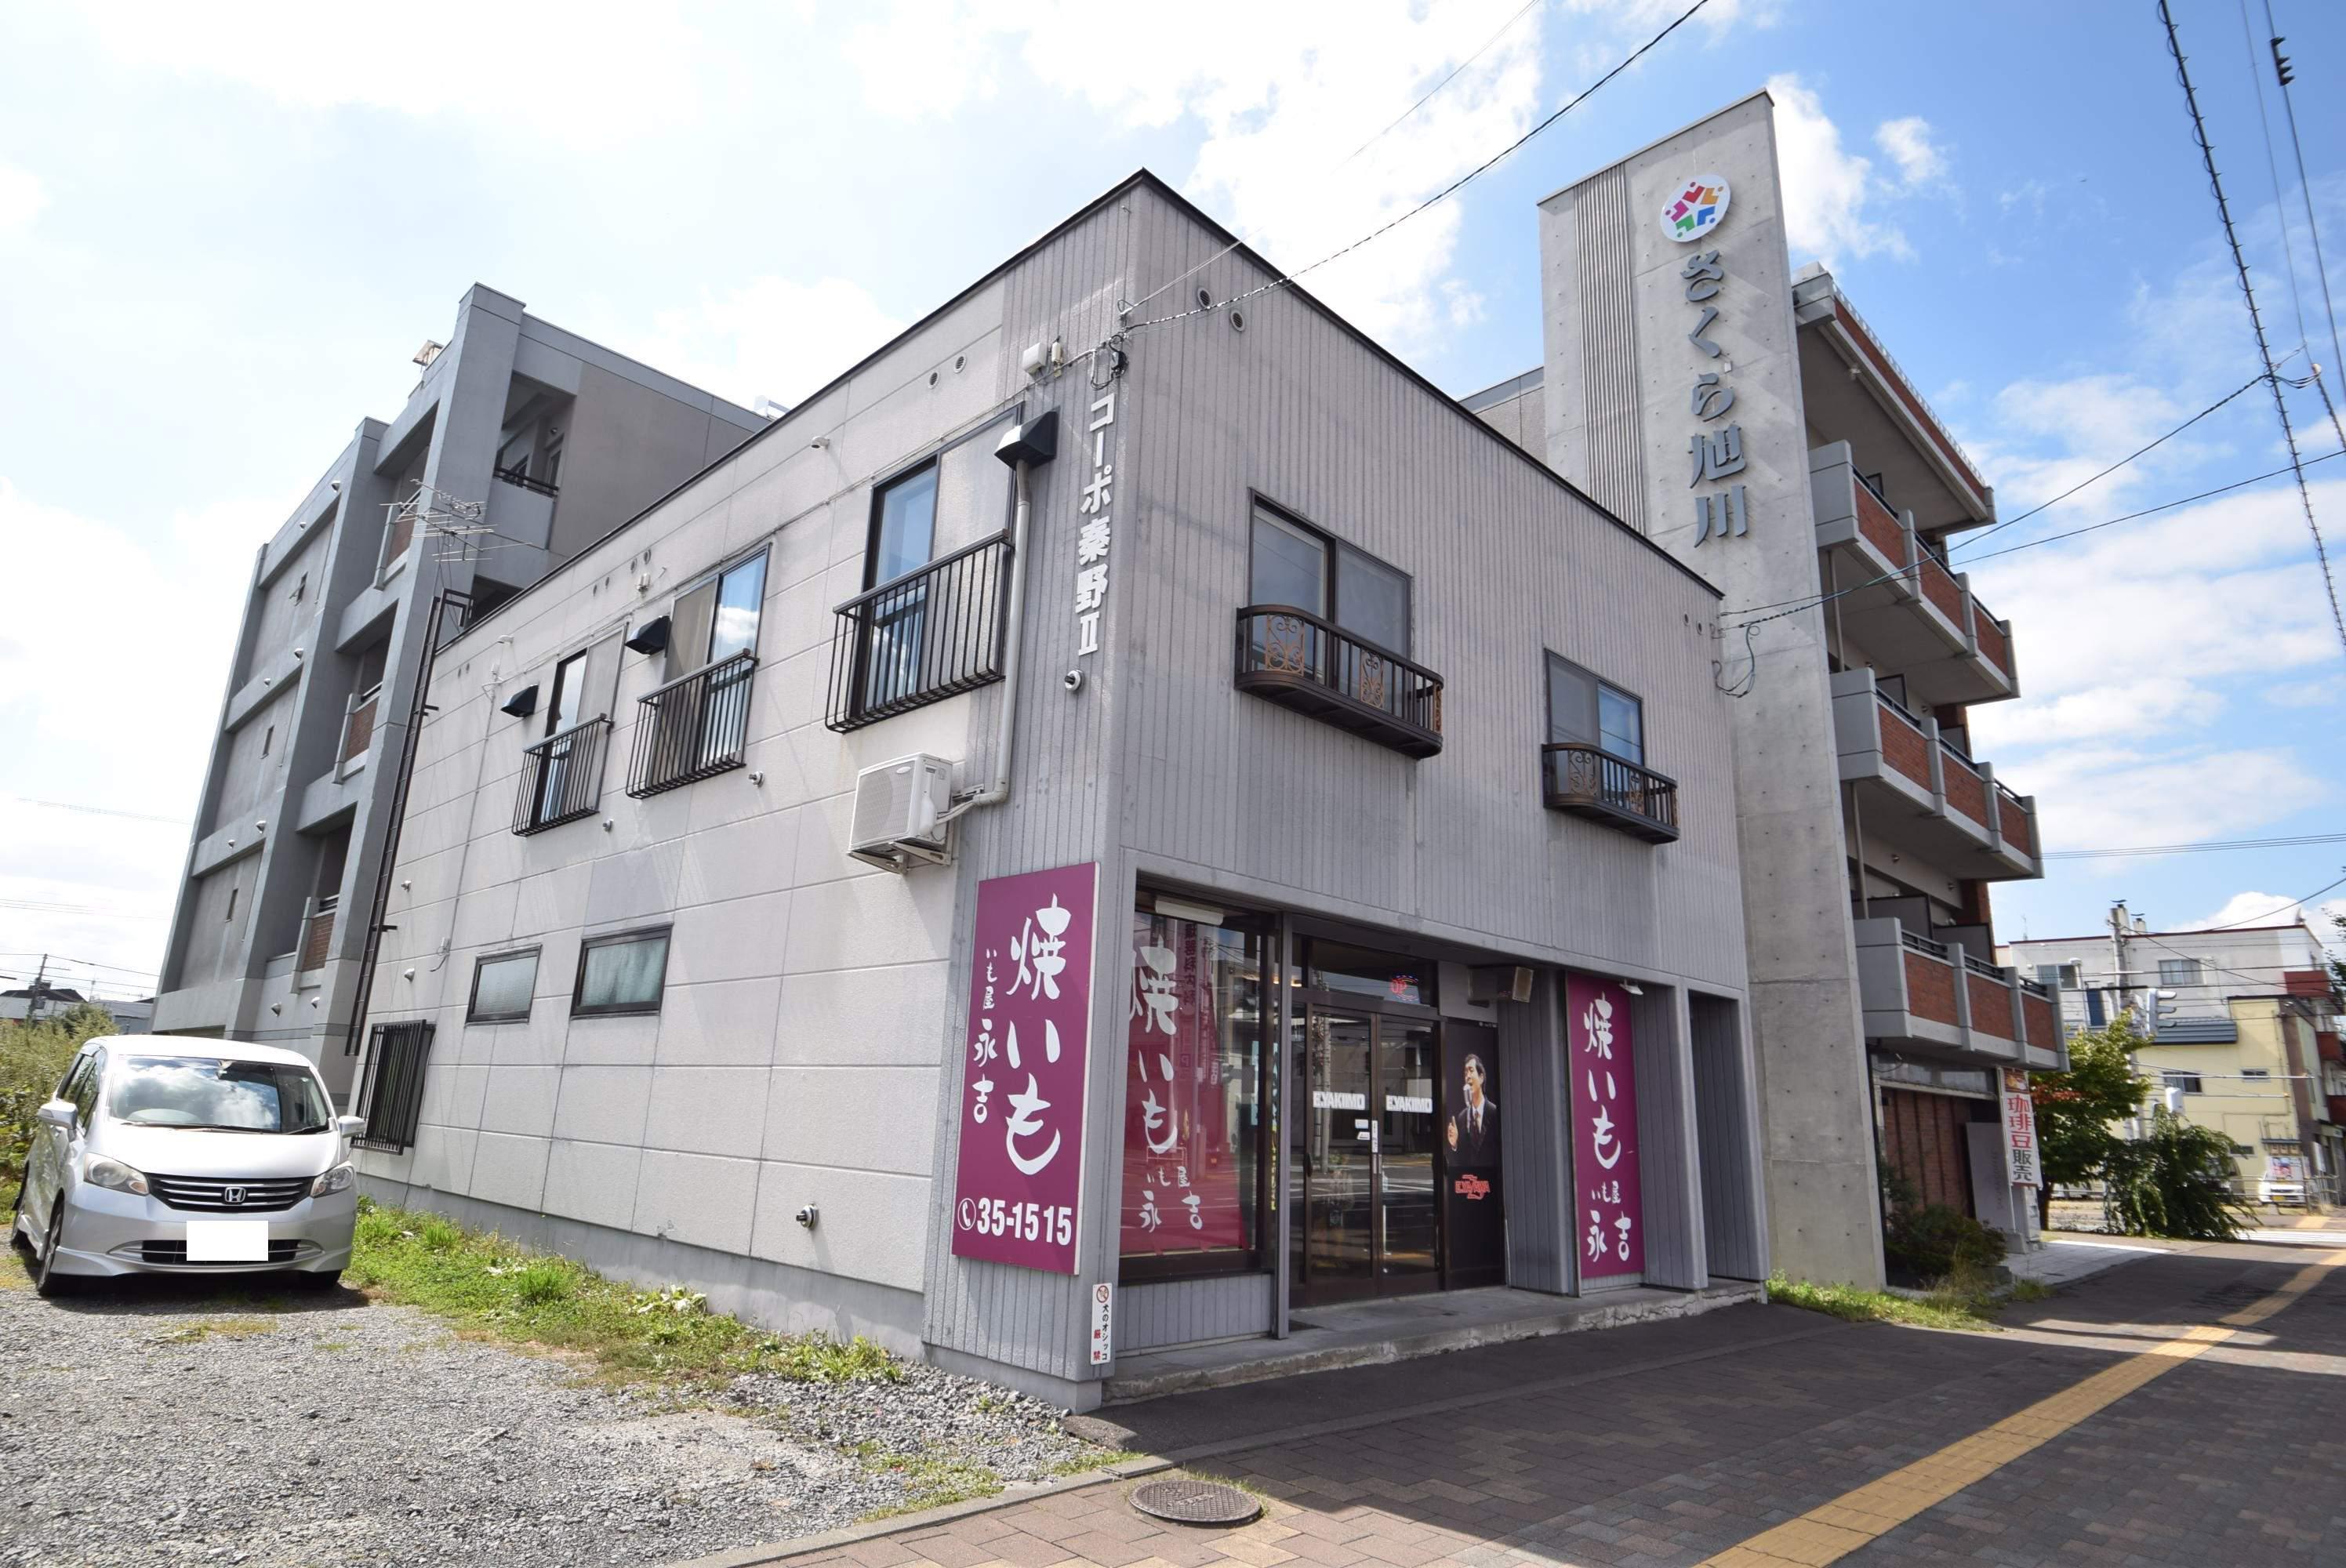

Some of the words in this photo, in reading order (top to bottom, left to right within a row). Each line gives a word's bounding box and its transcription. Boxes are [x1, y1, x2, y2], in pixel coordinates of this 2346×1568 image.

[1680, 248, 1747, 548] さくら旭川
[1005, 892, 1072, 1175] 焼いも
[1130, 933, 1178, 1155] 焼いも
[1583, 991, 1622, 1170] 焼いも
[1146, 1165, 1191, 1189] いも屋
[1591, 1180, 1622, 1203] いも屋
[2007, 1094, 2032, 1181] 珈琲豆販売
[976, 1196, 1073, 1247] 35-1515
